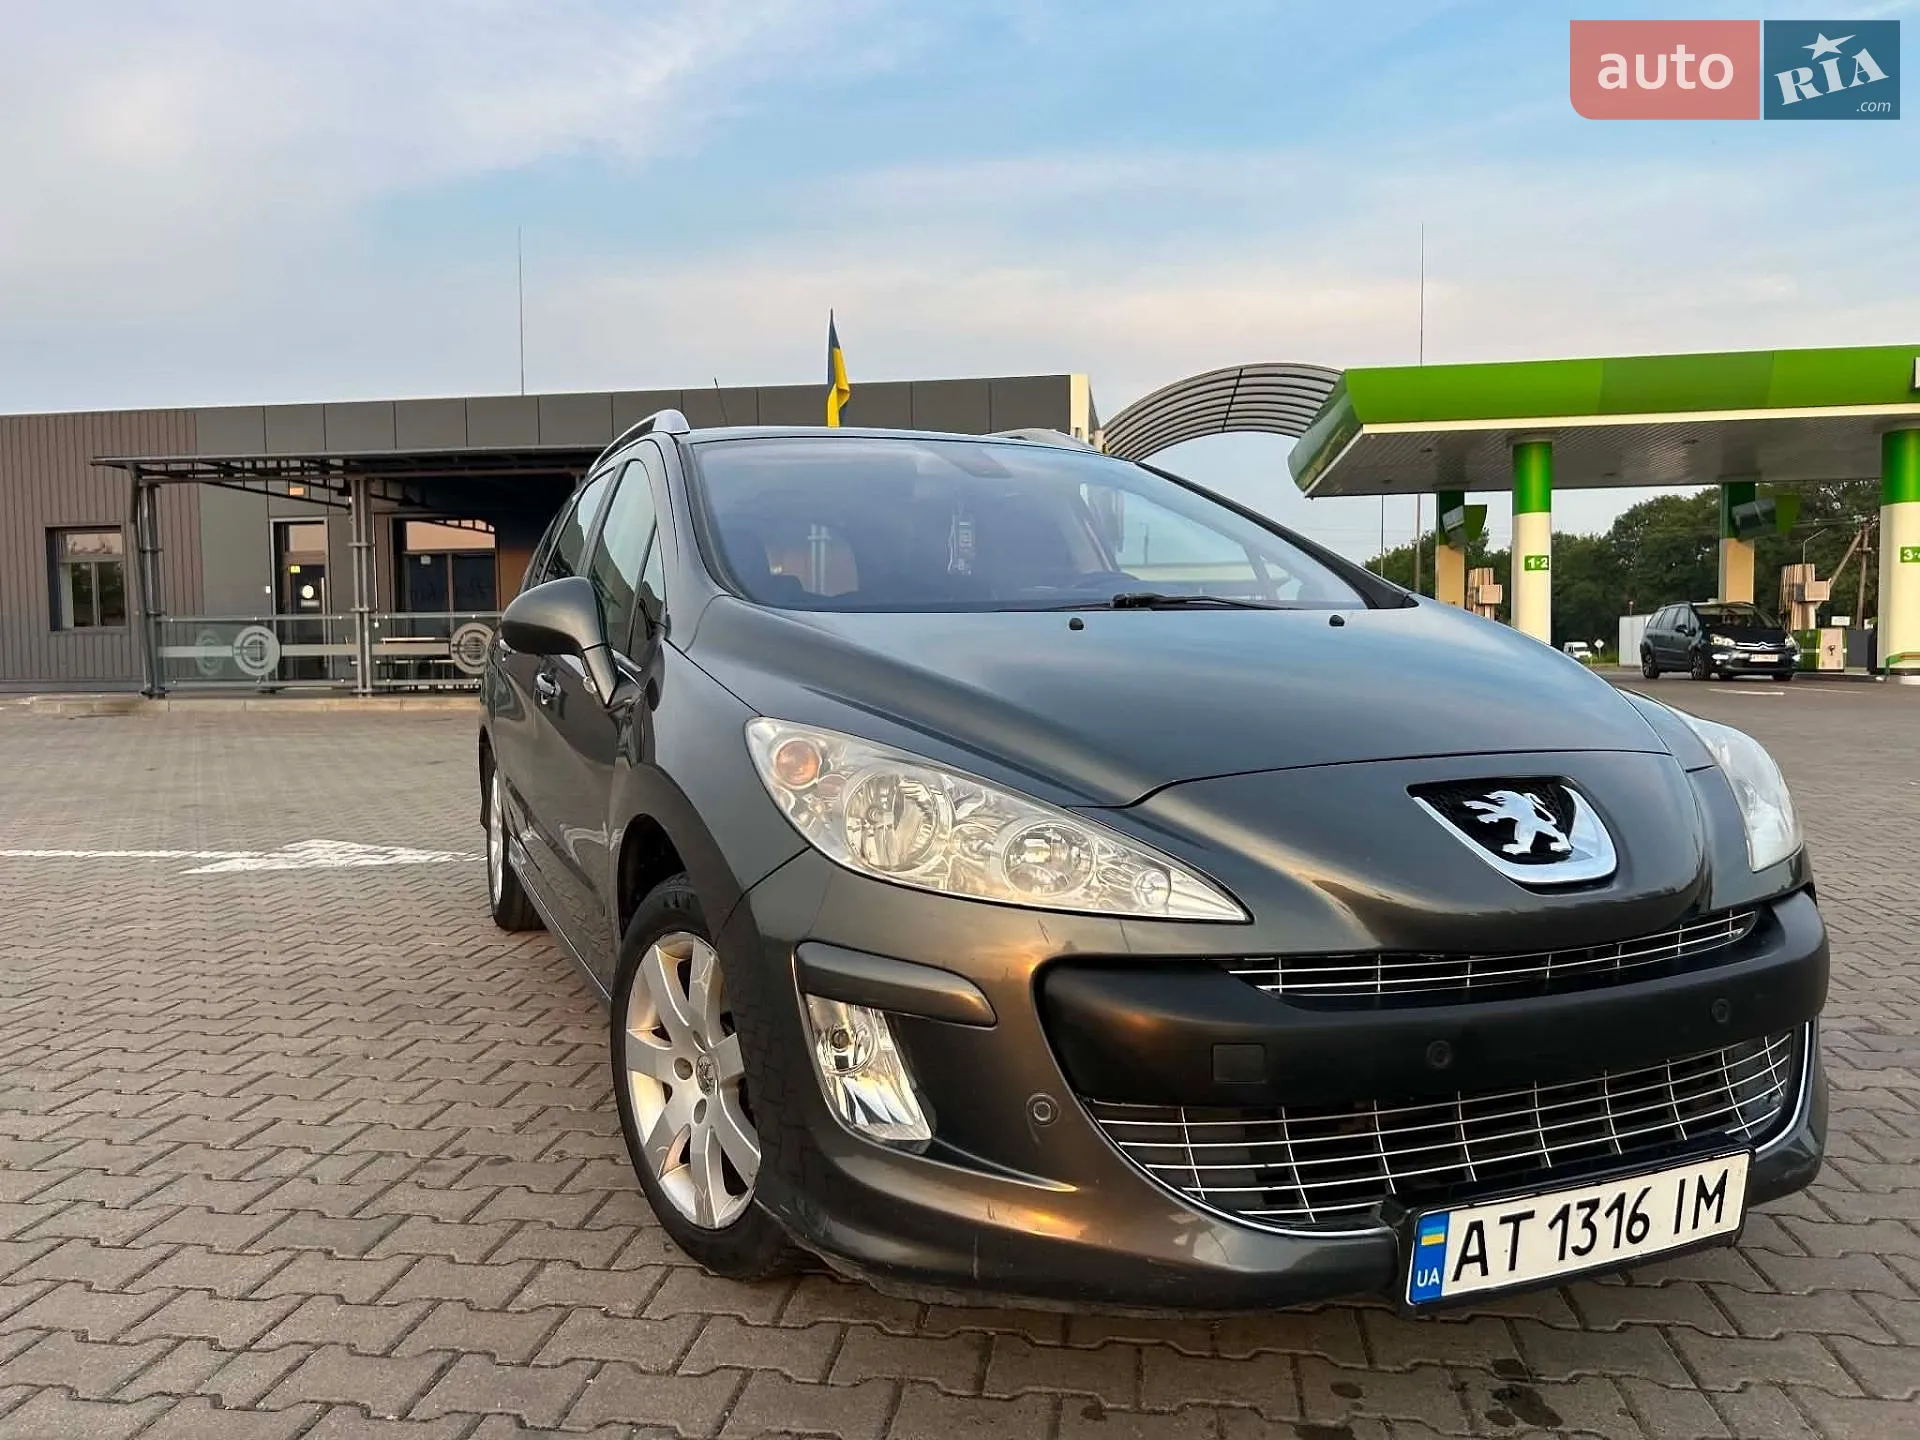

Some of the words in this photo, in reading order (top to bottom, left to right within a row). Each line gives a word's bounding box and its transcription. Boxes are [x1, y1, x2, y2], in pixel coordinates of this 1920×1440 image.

[1452, 1210, 1535, 1282] AT
[1548, 1186, 1652, 1262] 1316
[1674, 1169, 1729, 1235] IM
[1417, 1267, 1440, 1287] UA
